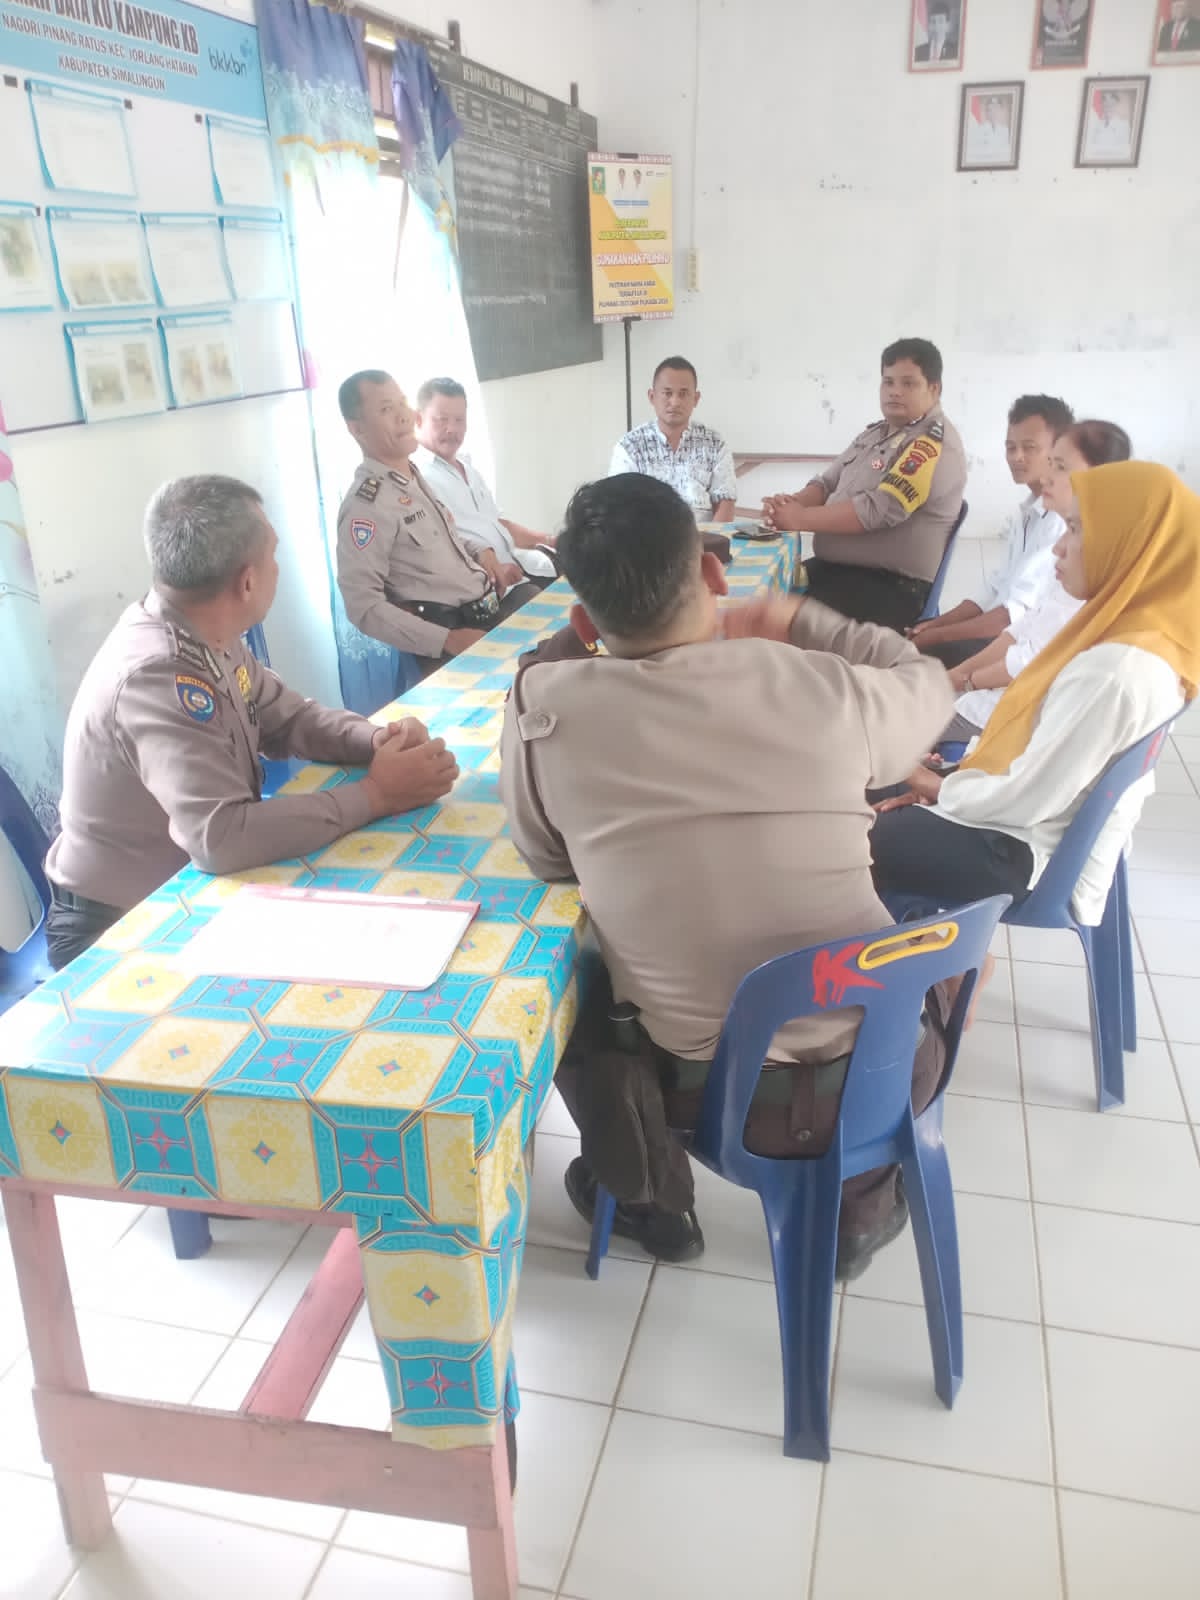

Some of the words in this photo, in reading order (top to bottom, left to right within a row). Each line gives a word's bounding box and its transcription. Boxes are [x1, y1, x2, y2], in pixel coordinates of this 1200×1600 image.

[2, 13, 41, 36] NAGORI
[42, 23, 77, 46] PINANG
[78, 34, 107, 54] RATUS
[114, 1, 180, 49] KAMPUNG
[181, 23, 199, 55] KB
[58, 55, 110, 79] KABUPATEN
[111, 66, 166, 91] SIMALUNGUN
[208, 47, 247, 77] bkkbn
